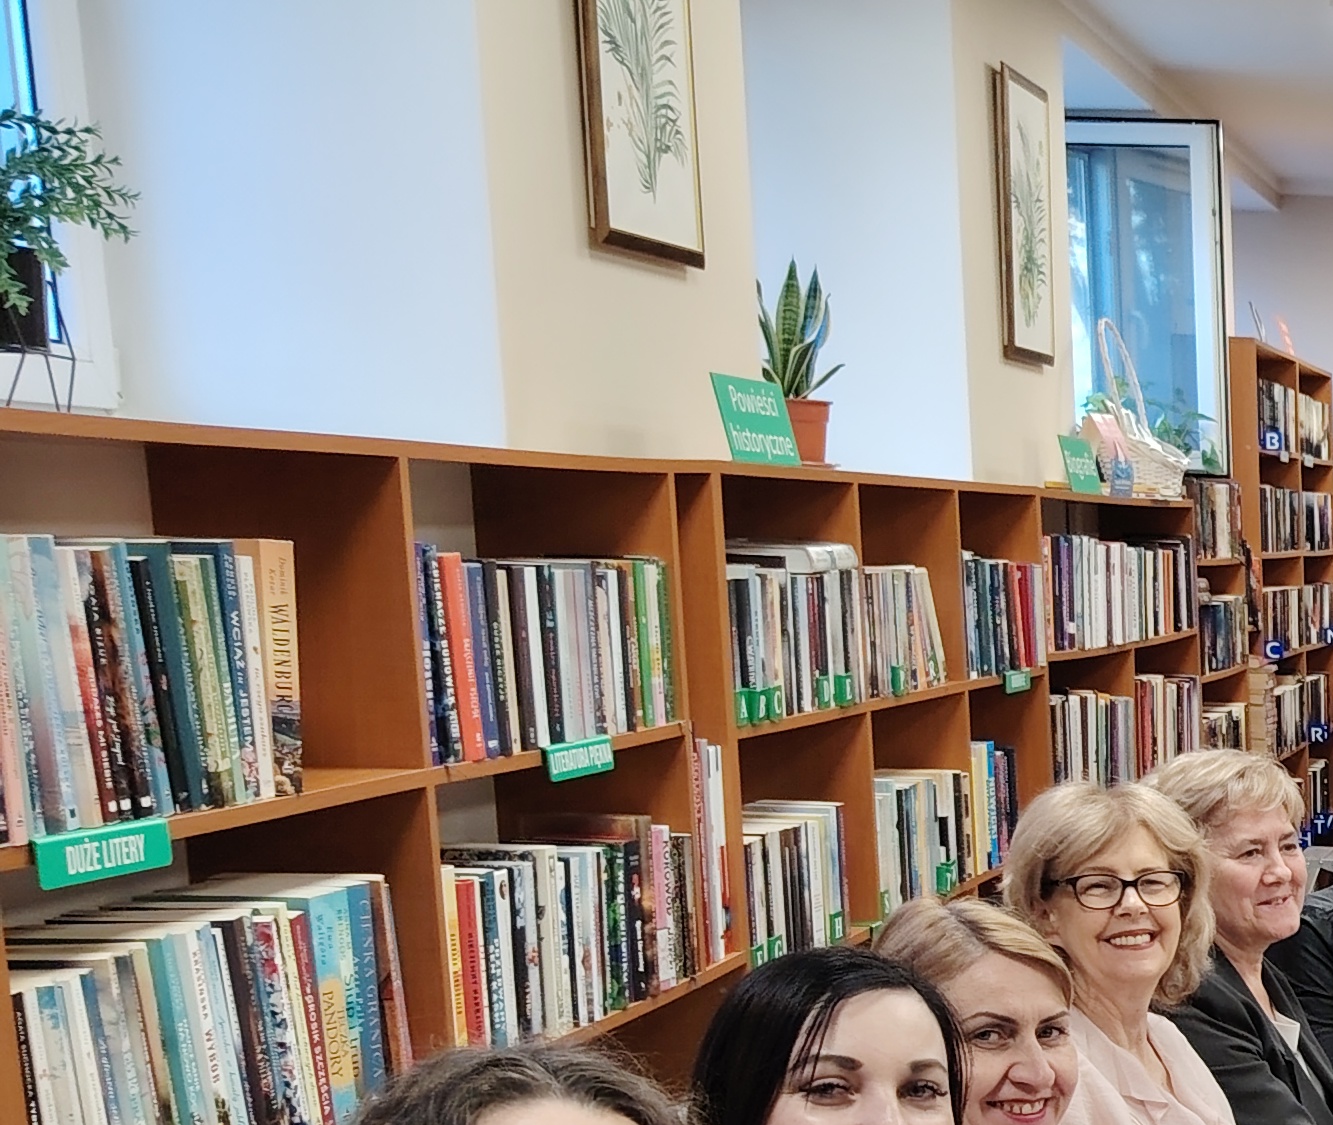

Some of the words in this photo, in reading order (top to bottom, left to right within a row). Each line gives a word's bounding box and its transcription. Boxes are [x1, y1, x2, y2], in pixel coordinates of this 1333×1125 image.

[727, 384, 779, 417] Powieści
[729, 423, 796, 460] historyczne
[1266, 432, 1279, 450] B
[1266, 642, 1280, 659] C
[230, 611, 245, 669] WCIĄŻ
[239, 689, 254, 752] JESTEM
[823, 680, 830, 703] D
[741, 694, 748, 718] A
[759, 695, 767, 718] B
[774, 691, 782, 714] C
[551, 747, 589, 773] LITERATURA
[66, 838, 100, 876] DUŻE
[101, 833, 145, 870] LITERY
[836, 916, 843, 938] H
[322, 990, 343, 1078] PANDORY
